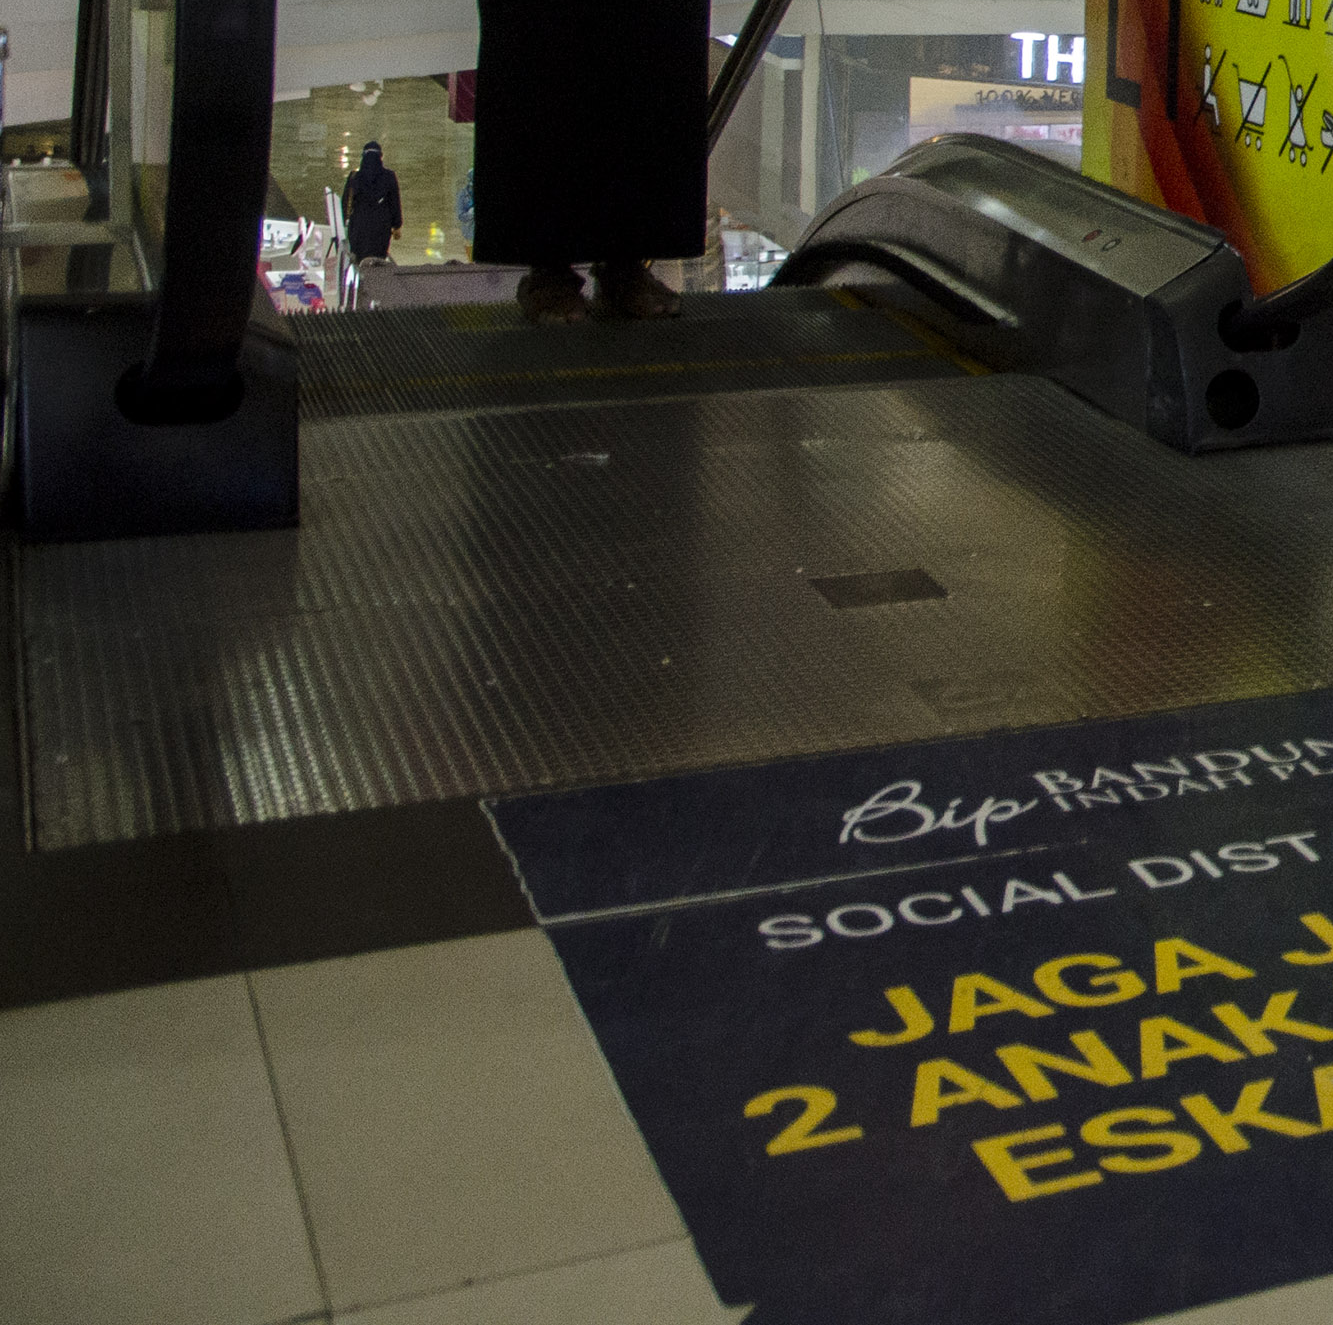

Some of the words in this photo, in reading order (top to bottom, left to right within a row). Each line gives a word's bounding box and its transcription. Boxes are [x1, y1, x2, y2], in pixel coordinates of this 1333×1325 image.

[840, 779, 1040, 846] Bip
[1053, 772, 1254, 812] INDAH
[756, 871, 1117, 950] SOCIAL
[848, 937, 1257, 1048] JAGA
[742, 1085, 863, 1156] 2
